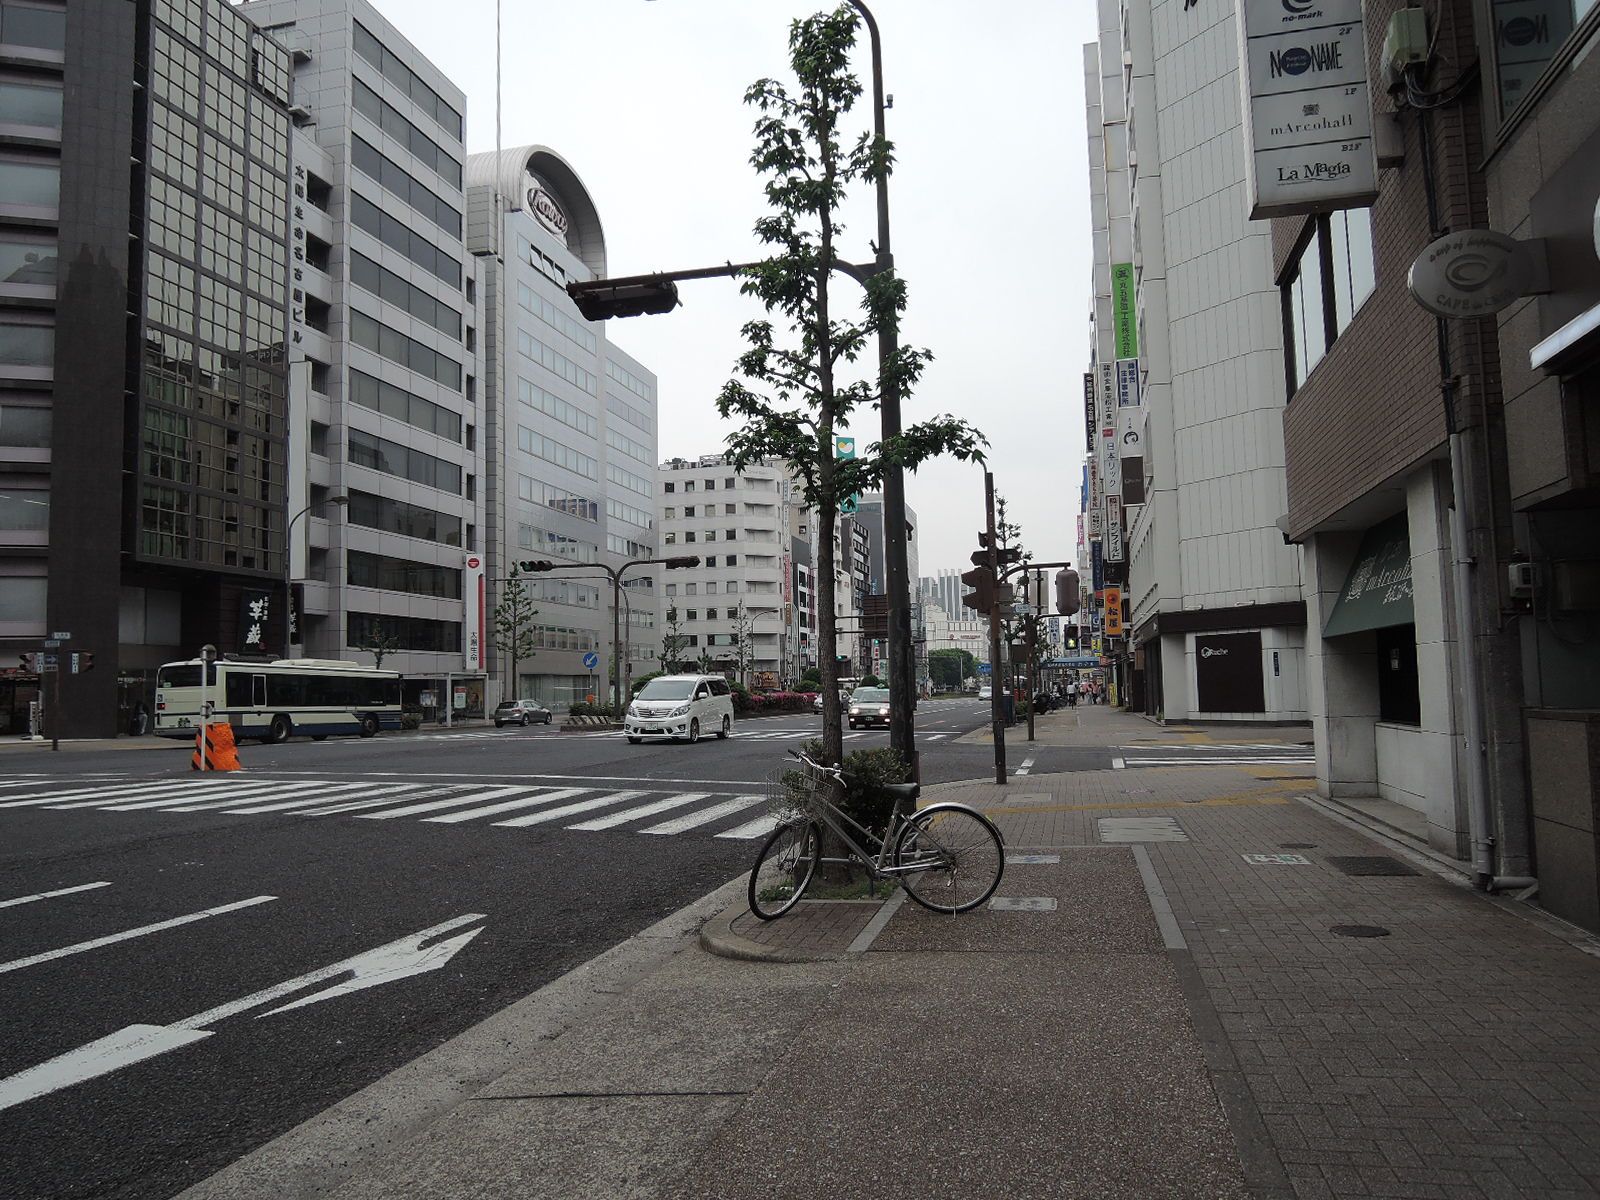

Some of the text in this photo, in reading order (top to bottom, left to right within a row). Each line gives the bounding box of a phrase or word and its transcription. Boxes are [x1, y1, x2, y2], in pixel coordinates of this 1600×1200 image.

[1281, 10, 1324, 23] no-mark
[1276, 166, 1298, 181] La
[292, 165, 305, 344] 太陽生命名古屋ビル
[1106, 442, 1117, 488] 日本リック
[1107, 606, 1119, 628] 松屋
